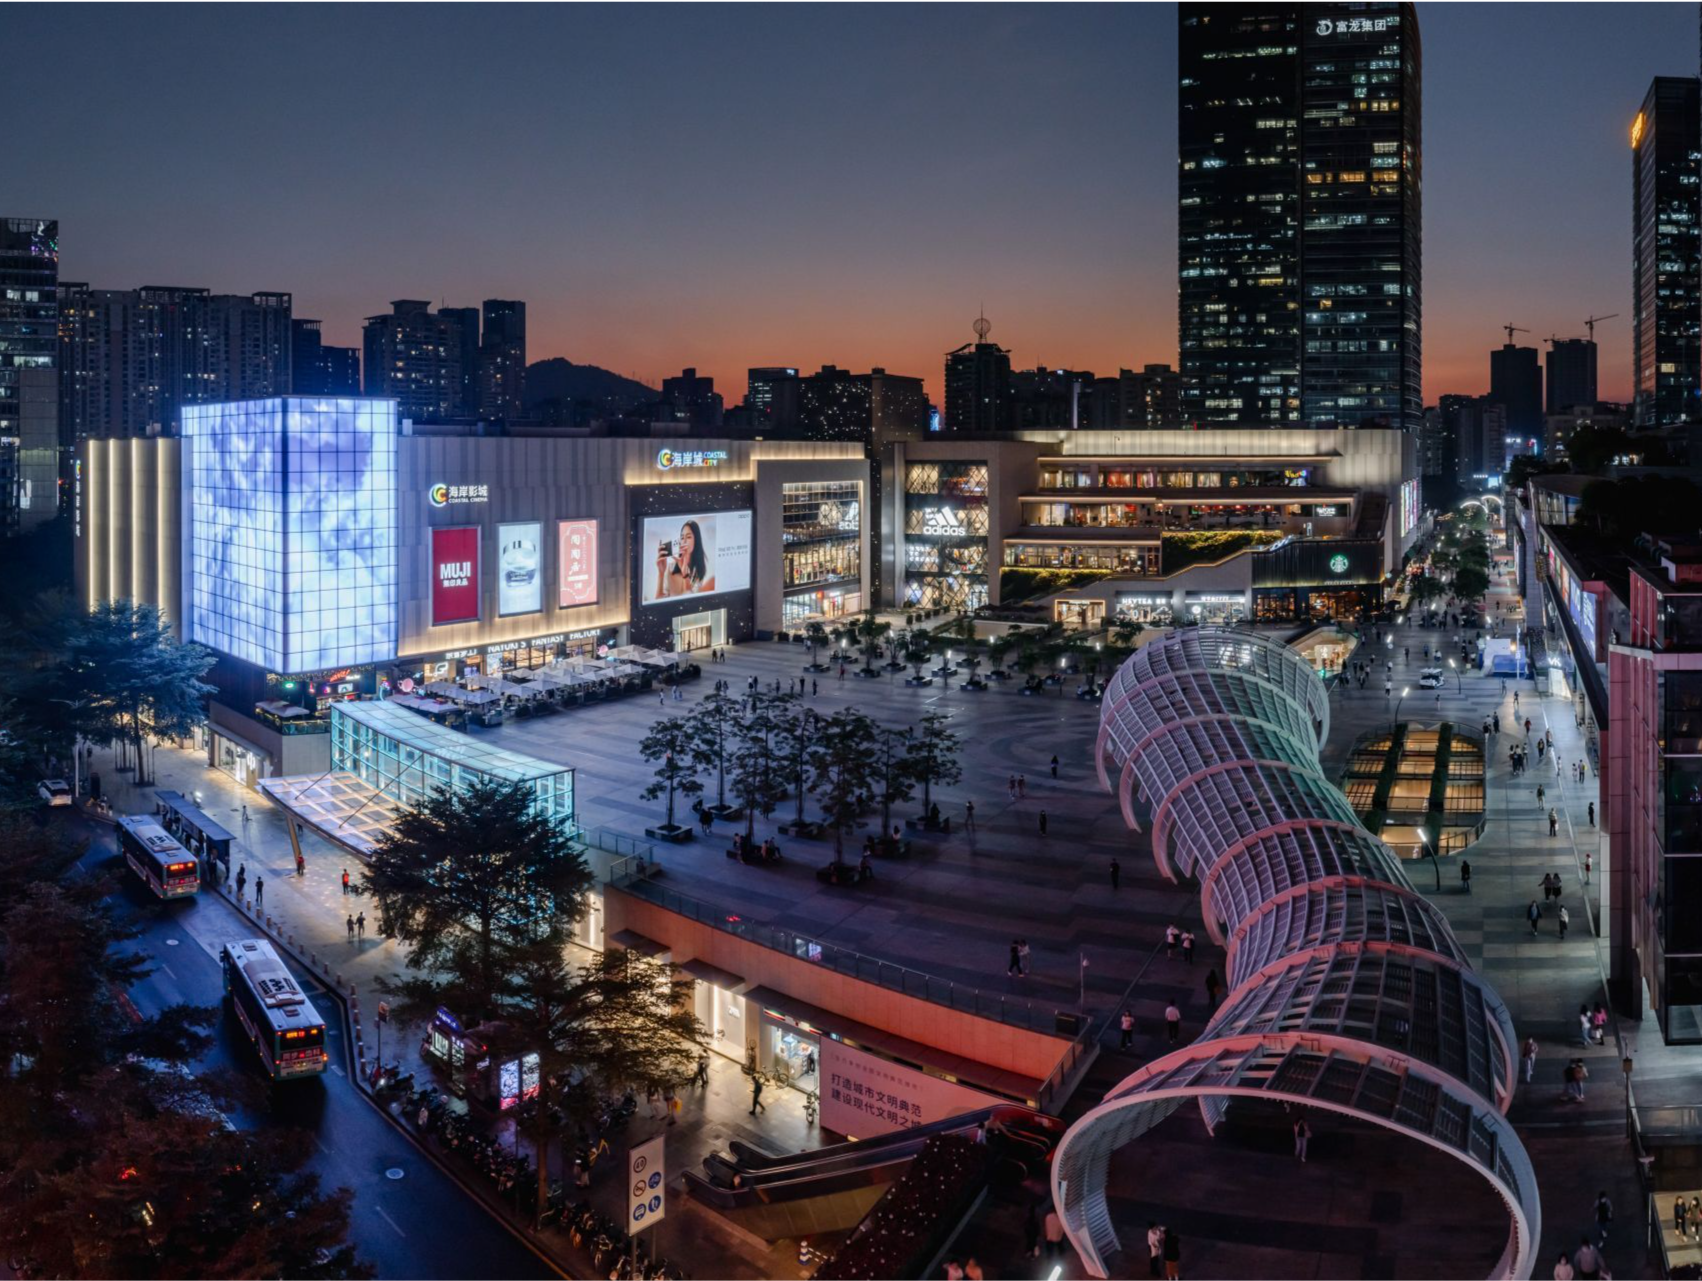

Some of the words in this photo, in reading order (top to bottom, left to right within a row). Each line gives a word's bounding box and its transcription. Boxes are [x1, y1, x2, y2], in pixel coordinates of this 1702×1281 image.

[1336, 20, 1386, 33] 富龙集团
[671, 452, 703, 467] 海岸城
[704, 451, 727, 459] COASTAL
[704, 459, 717, 467] CITY
[449, 485, 488, 498] 海岸影城
[923, 524, 966, 536] adidas
[440, 561, 471, 580] MUJI
[831, 1073, 922, 1118] 打造城市文明典范
